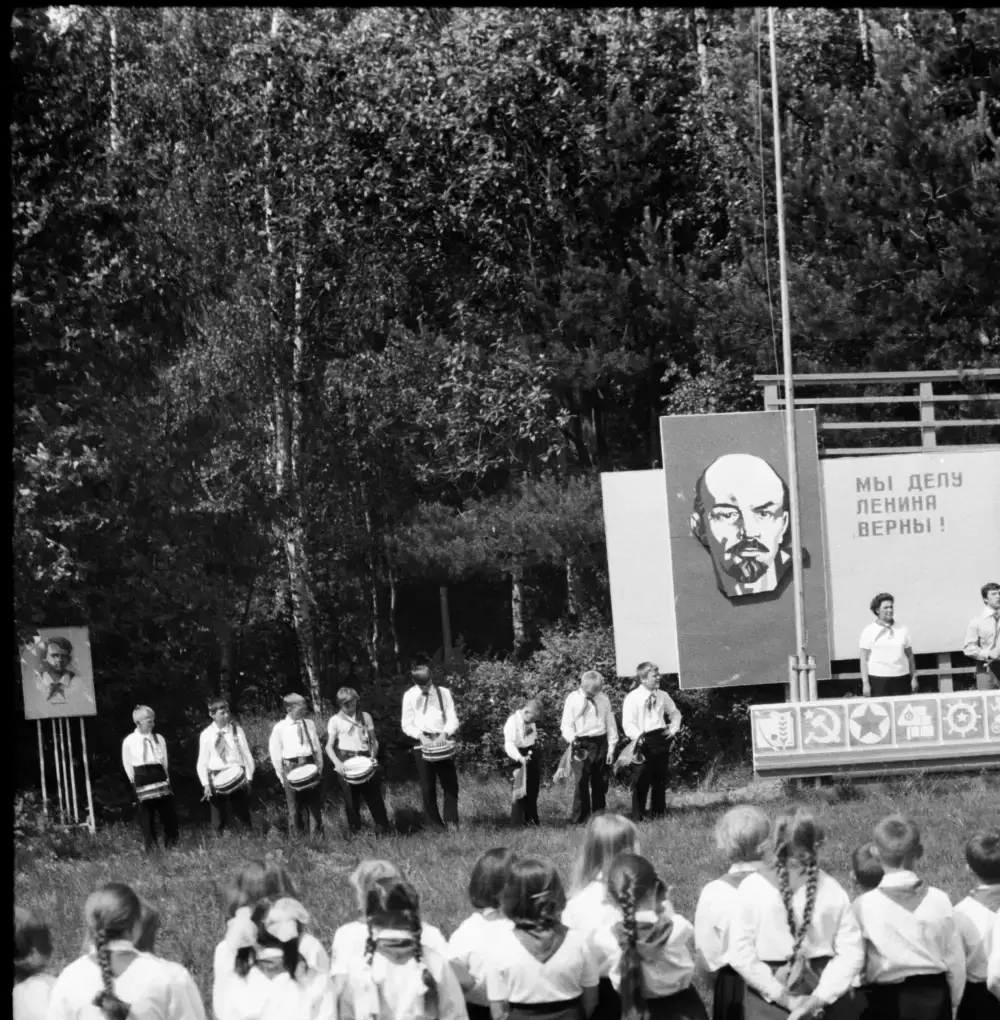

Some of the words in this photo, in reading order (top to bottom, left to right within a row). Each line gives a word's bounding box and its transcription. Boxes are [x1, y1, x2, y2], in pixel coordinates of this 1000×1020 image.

[856, 475, 893, 493] МЫ
[908, 471, 963, 492] ДЕЛУ
[856, 494, 937, 515] ЛЕНИНА
